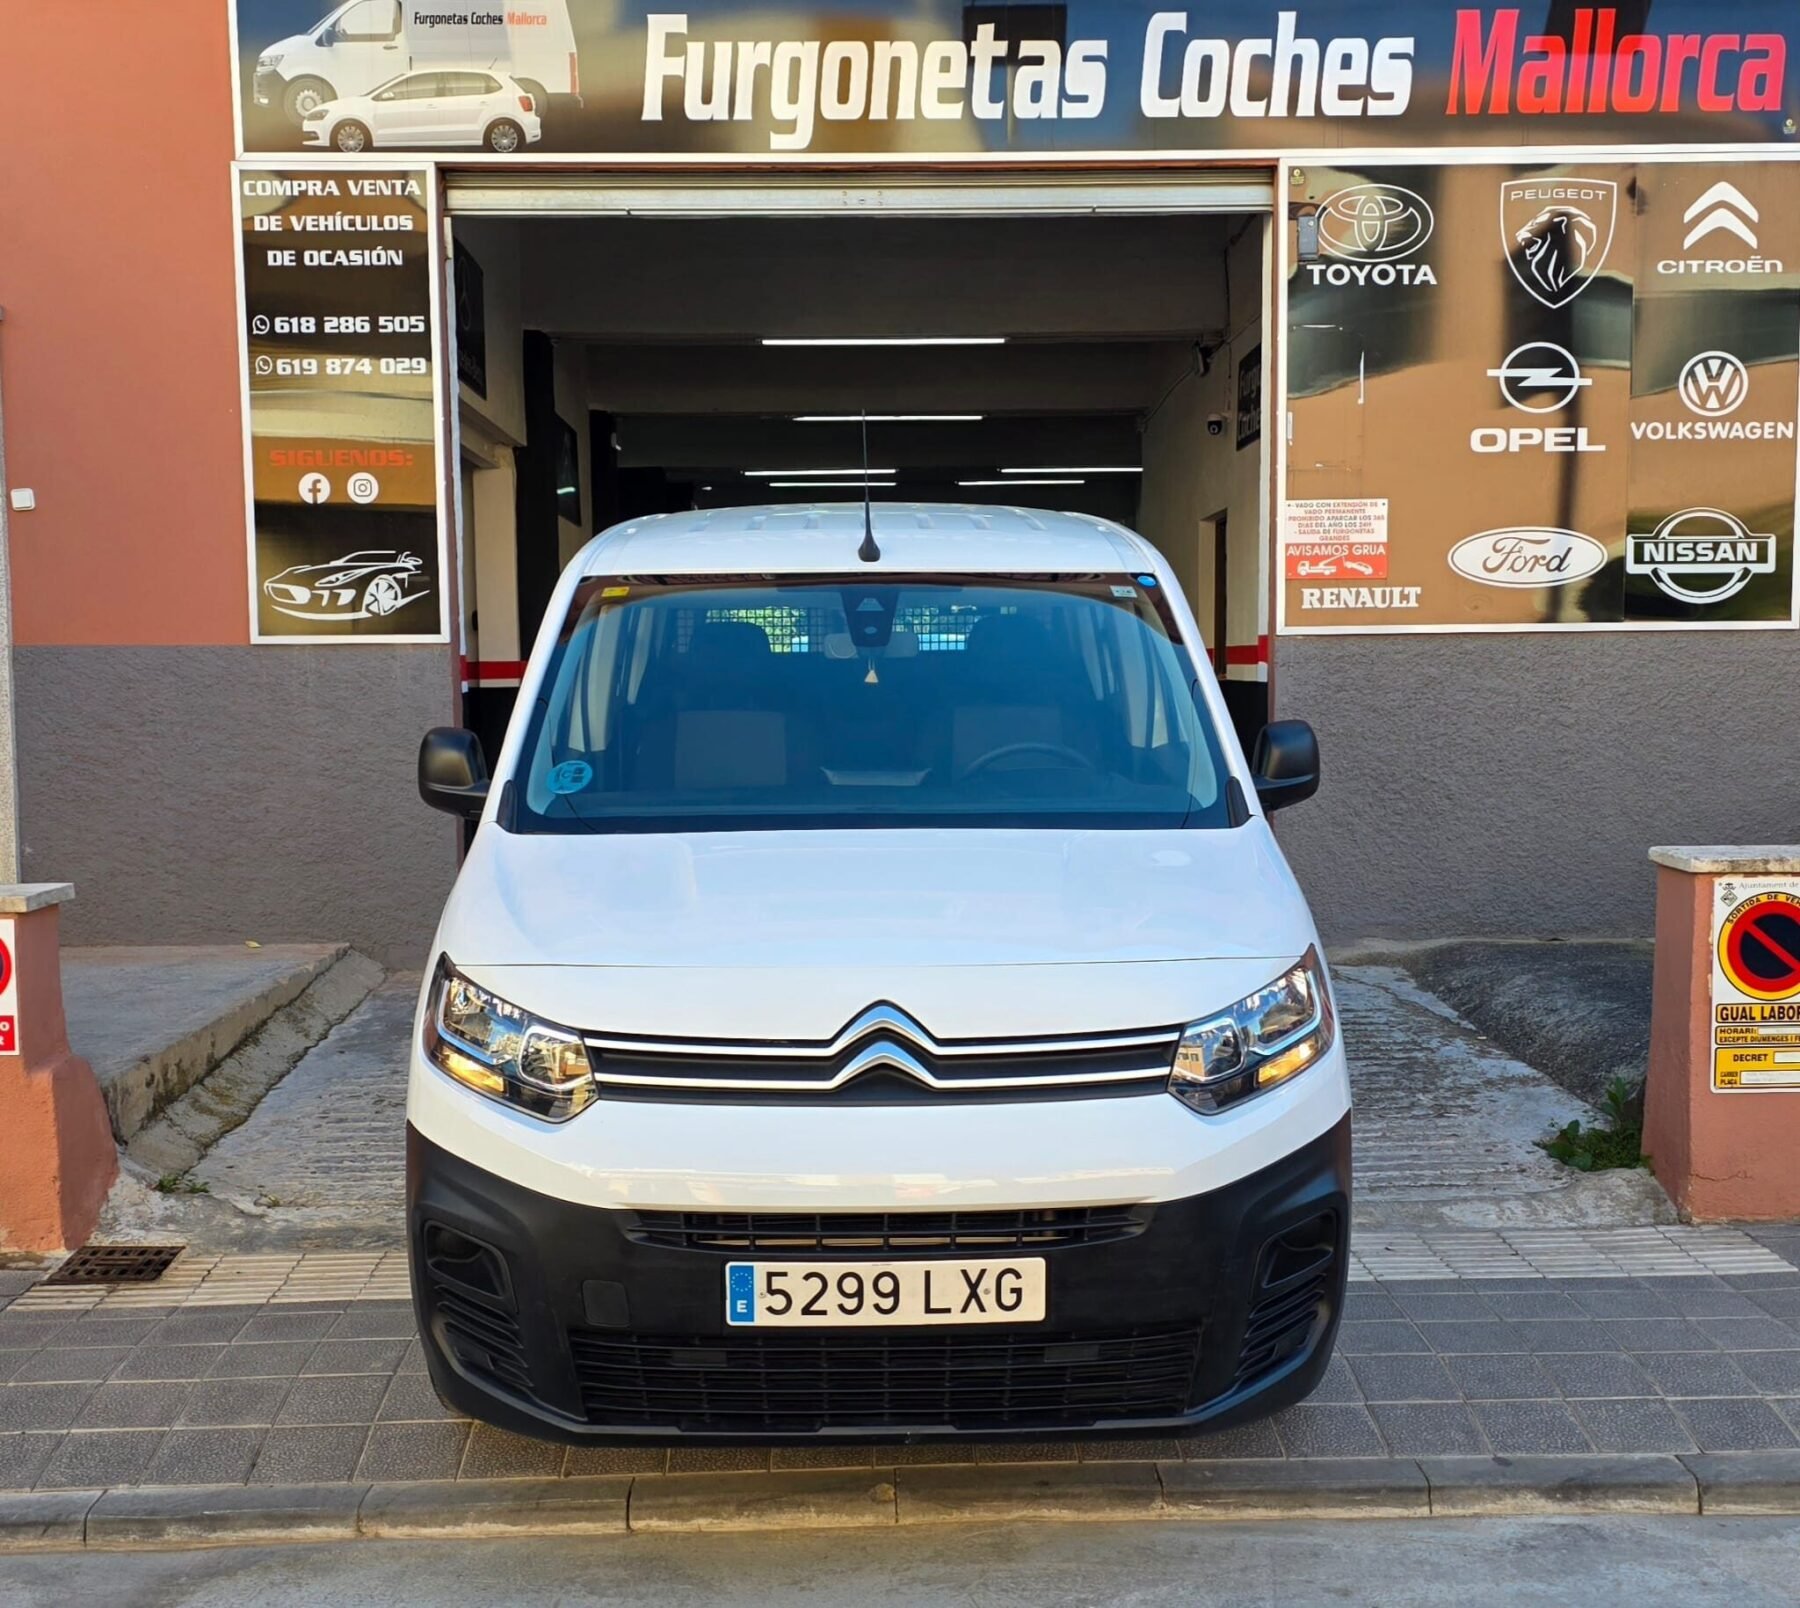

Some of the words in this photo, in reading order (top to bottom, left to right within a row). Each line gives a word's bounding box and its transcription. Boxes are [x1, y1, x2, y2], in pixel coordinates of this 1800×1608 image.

[415, 12, 468, 27] Furgonetas
[470, 12, 503, 26] Coches
[507, 12, 547, 26] Mallorca
[641, 14, 1108, 150] Furgonetas
[1140, 11, 1415, 118] Coches
[1446, 8, 1787, 115] Mallorca
[243, 180, 340, 196] COMPRA
[347, 179, 421, 196] VENTA
[1510, 188, 1607, 202] PEUGEOT
[254, 215, 282, 232] DE
[289, 211, 413, 232] VEHÍCULOS
[267, 250, 296, 266] DE
[303, 246, 403, 266] OCASIÓN
[1656, 255, 1783, 274] CITROËN
[1306, 263, 1437, 286] TOYOTA
[274, 317, 316, 333] 618
[323, 316, 370, 333] 286
[378, 316, 425, 333] 505
[276, 358, 318, 375] 619
[325, 358, 373, 375] 874
[380, 357, 427, 374] 029
[1470, 427, 1606, 453] OPEL
[1630, 421, 1794, 440] VOLKSWAGEN
[1286, 544, 1349, 556] AVISAMOS
[1352, 544, 1386, 556] GRUA
[1482, 536, 1573, 574] Ford
[1643, 542, 1758, 562] NISSAN
[1301, 586, 1422, 609] RENAULT
[1727, 897, 1761, 924] SORTIDA
[1720, 1006, 1756, 1021] GUAL
[1733, 1054, 1768, 1062] DECRET
[736, 1300, 748, 1312] E
[765, 1271, 901, 1316] 5299
[924, 1268, 1023, 1314] LXG
